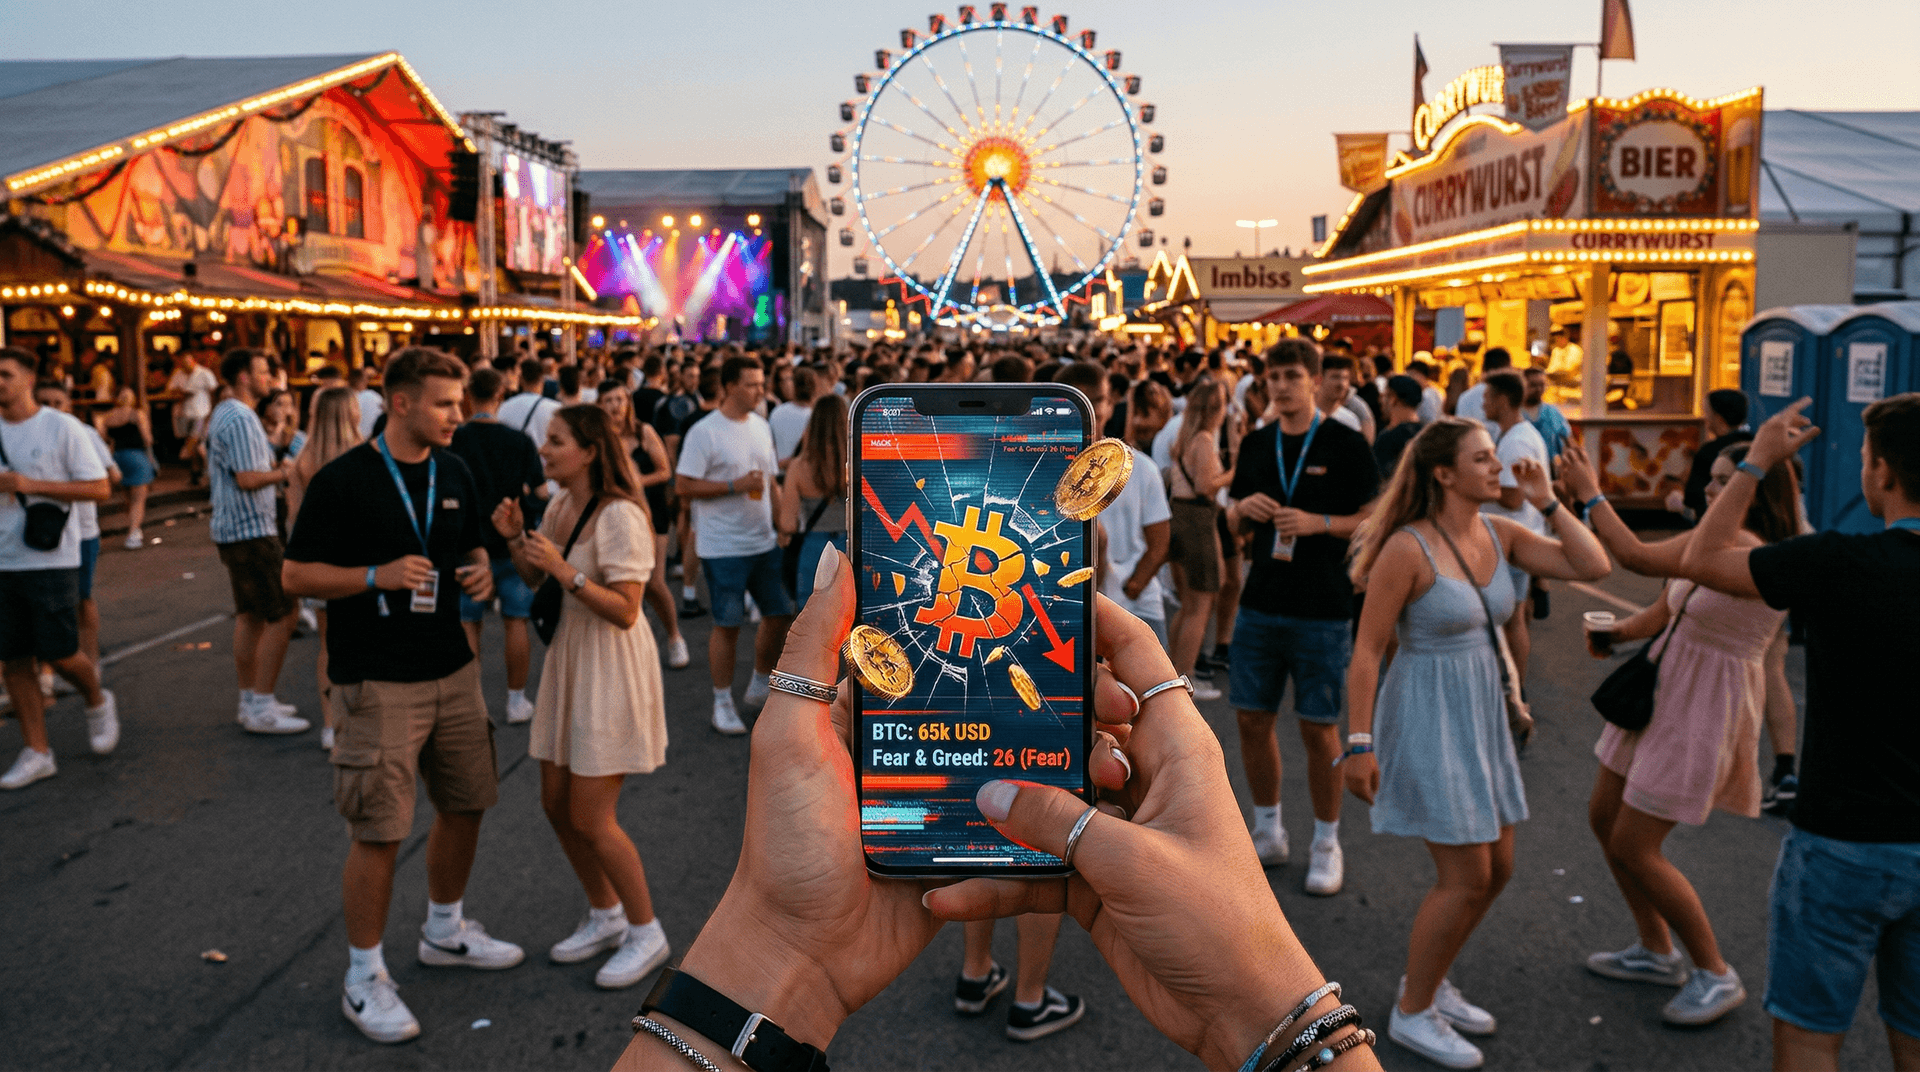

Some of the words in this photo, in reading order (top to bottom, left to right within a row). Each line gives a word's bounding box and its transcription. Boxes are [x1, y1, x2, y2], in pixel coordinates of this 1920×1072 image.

[1621, 147, 1696, 178] BIER
[1414, 145, 1545, 227] CURRYWURST
[1572, 233, 1715, 249] CURRYWURST
[1211, 264, 1291, 289] Imbiss
[872, 722, 913, 741] BTC:
[918, 722, 951, 741] 65k
[955, 722, 991, 741] USD
[872, 748, 910, 767] Fear
[915, 748, 927, 767] &
[932, 748, 989, 767] Greed:
[993, 748, 1015, 767] 26
[1020, 747, 1071, 771] (Fear)
